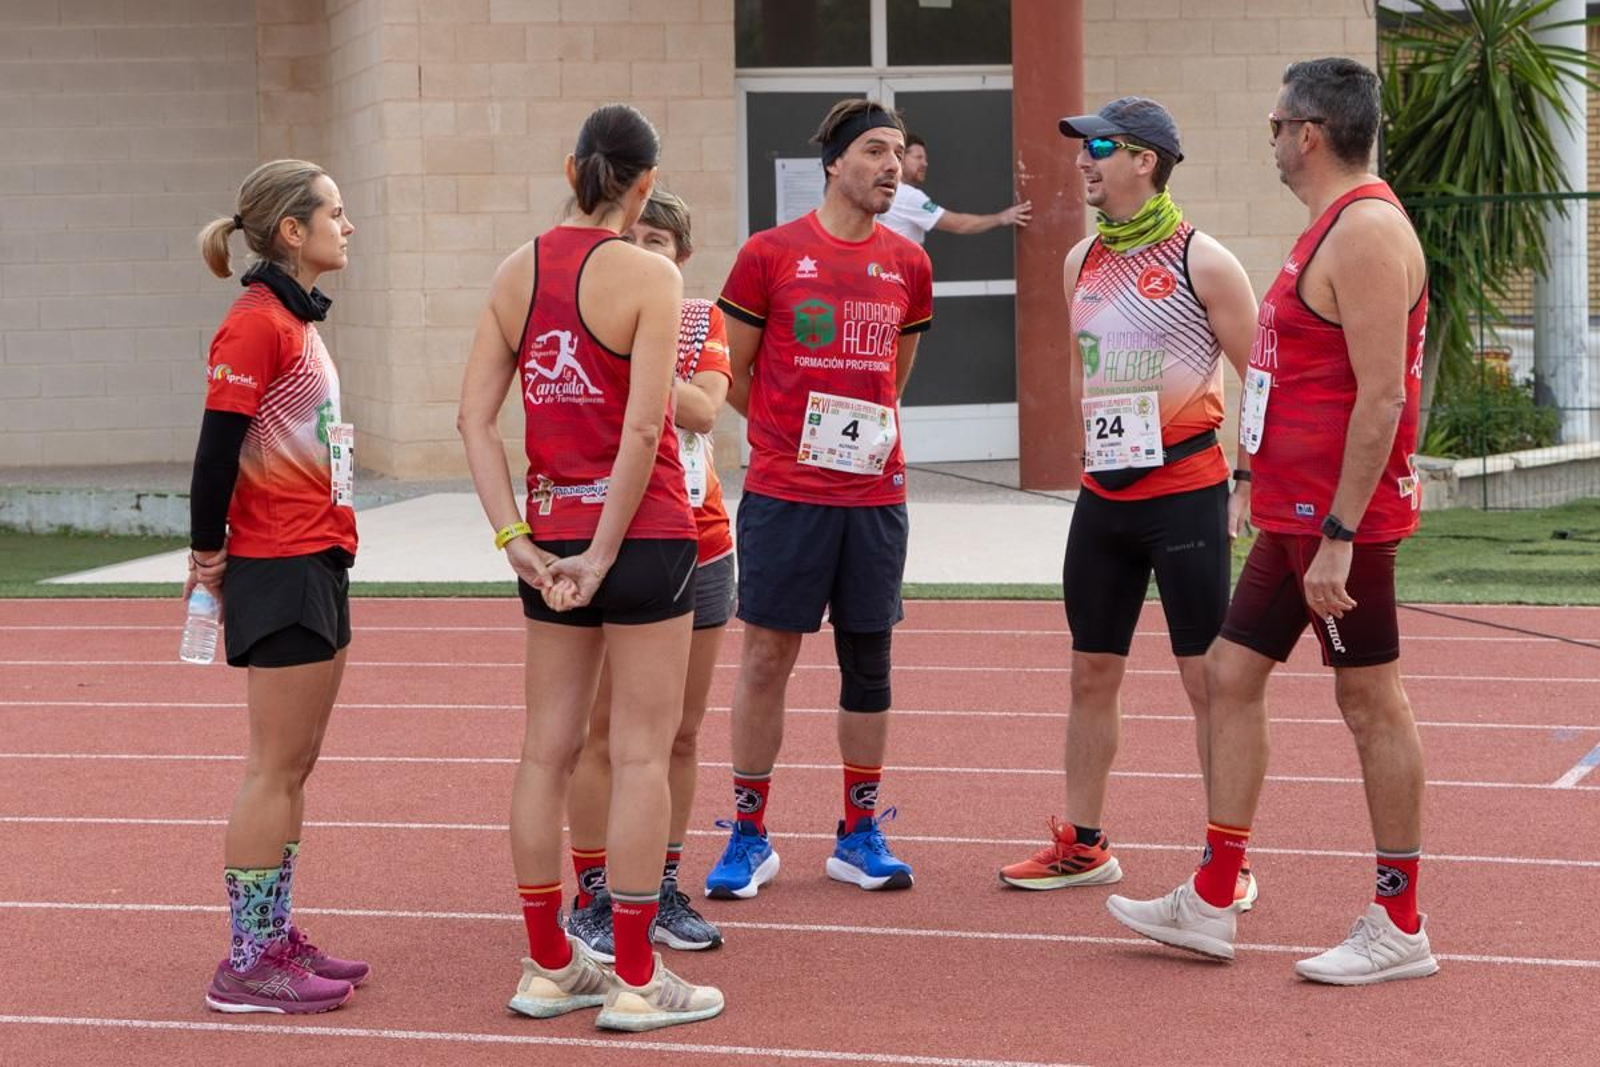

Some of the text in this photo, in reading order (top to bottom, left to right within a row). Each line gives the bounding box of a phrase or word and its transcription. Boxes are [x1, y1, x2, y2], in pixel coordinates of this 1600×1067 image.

[794, 354, 844, 371] FORMACIÓN
[841, 419, 859, 442] 4
[1095, 415, 1124, 440] 24
